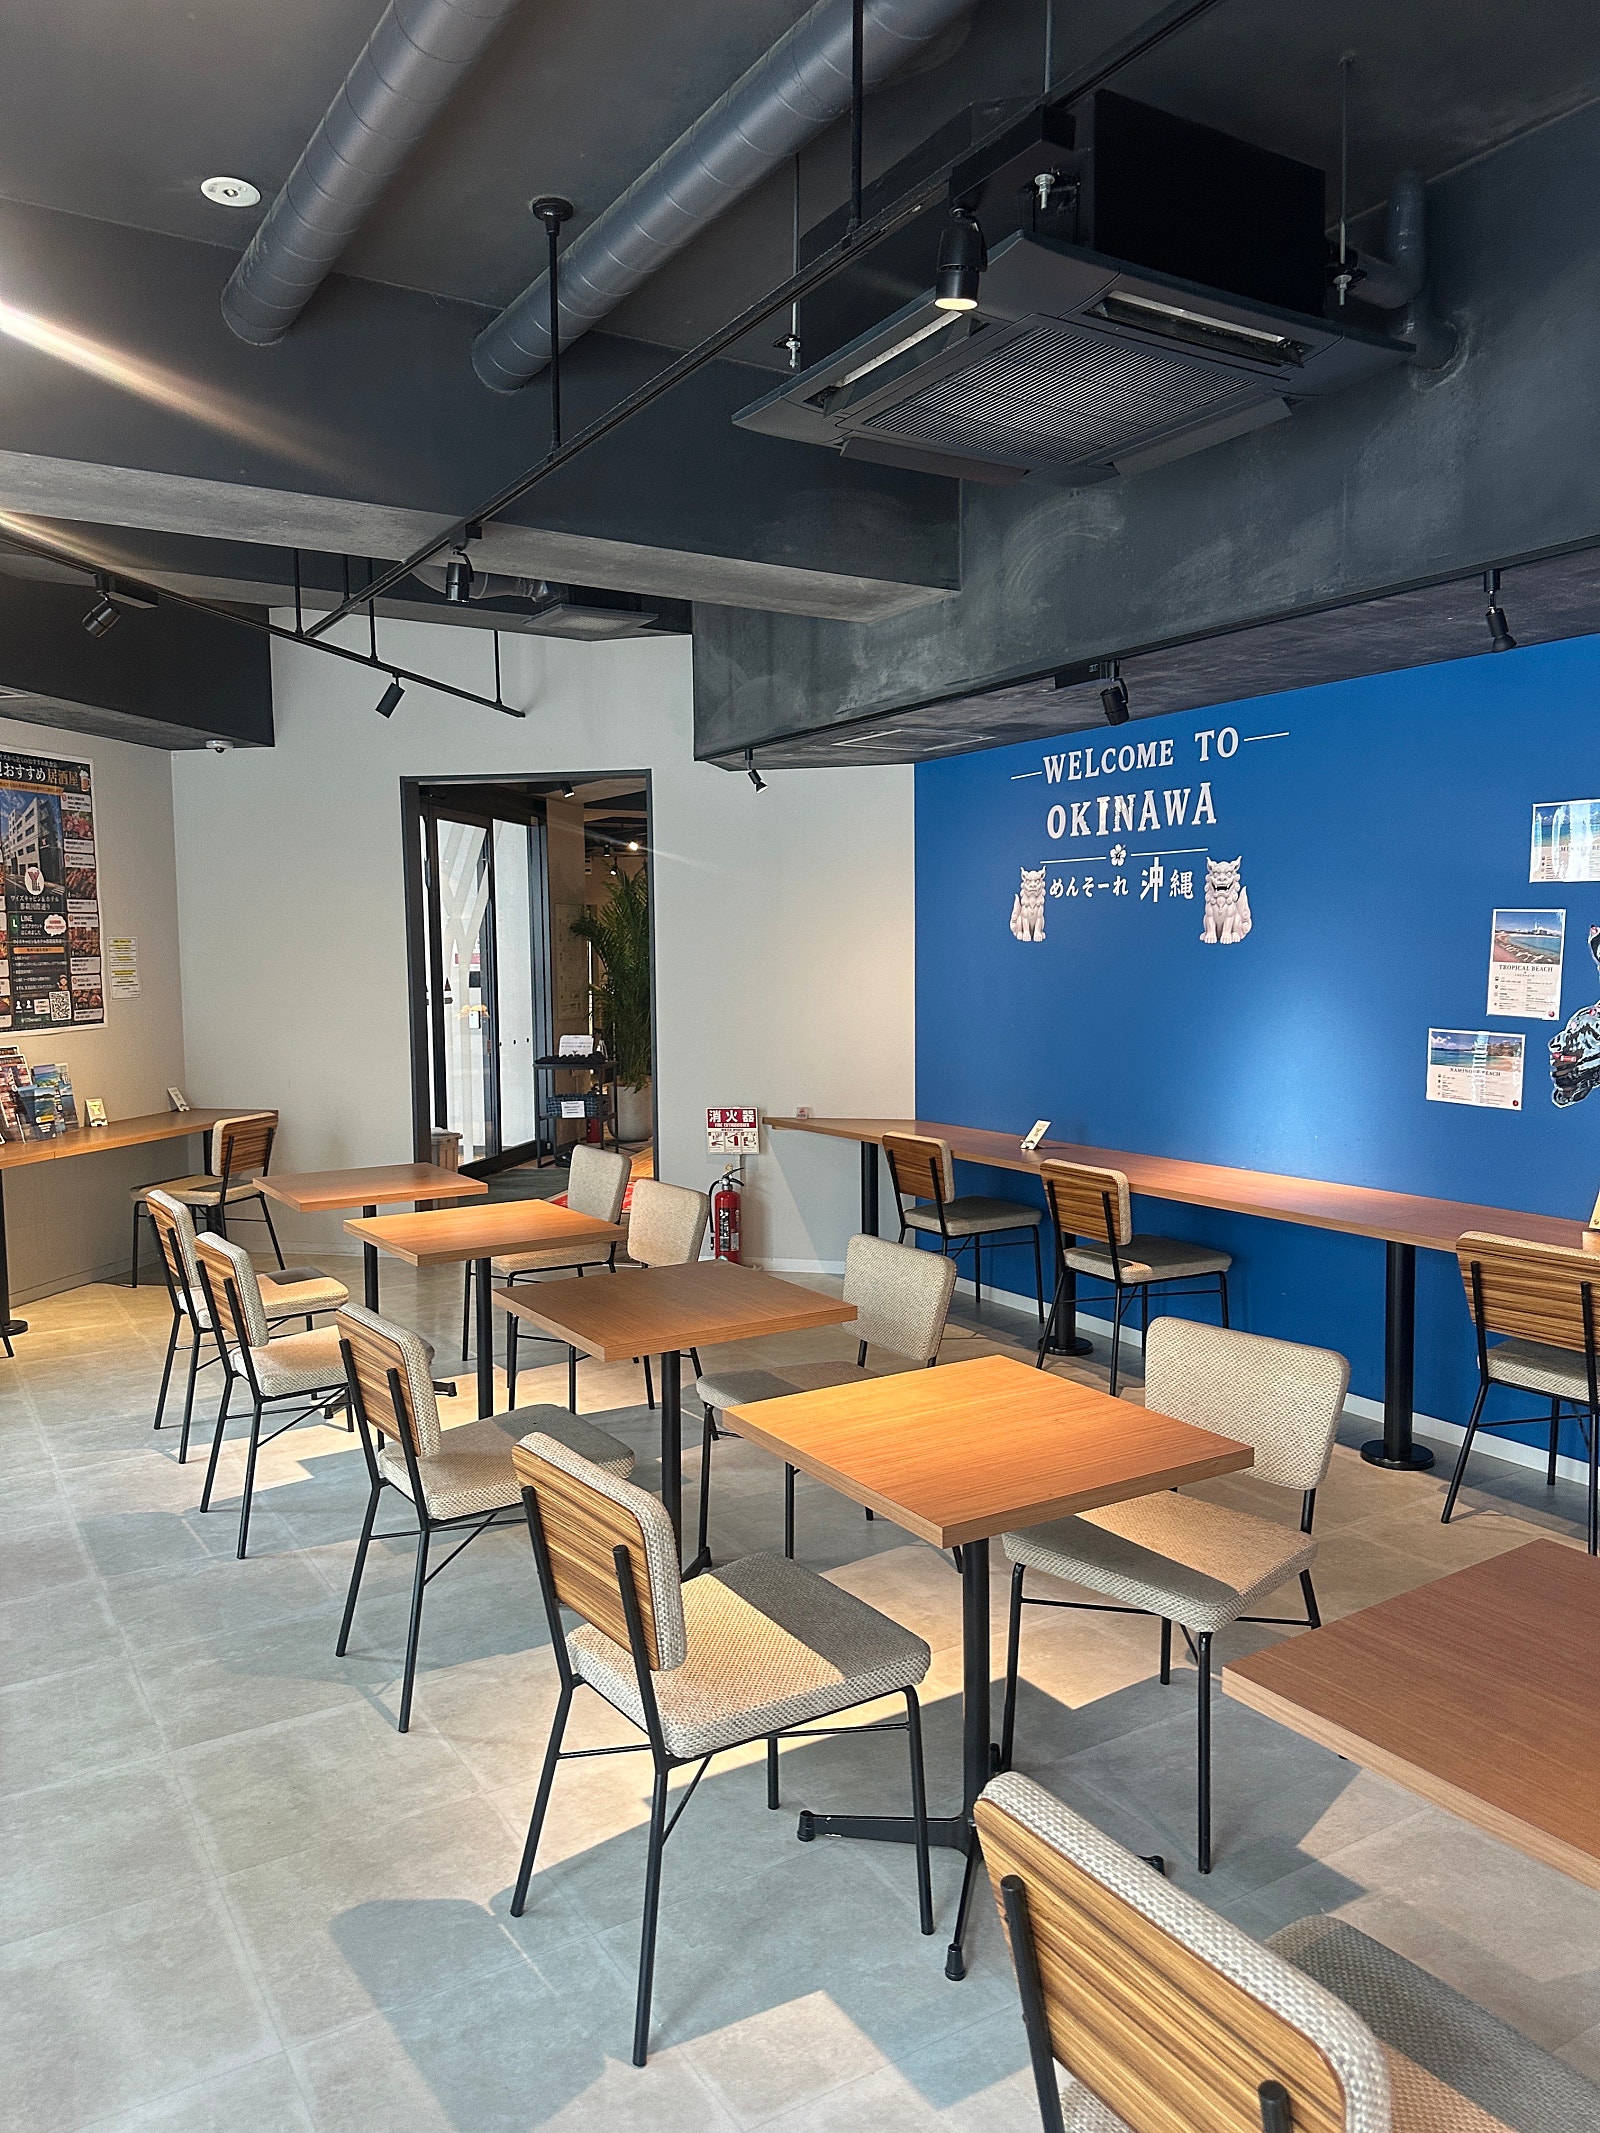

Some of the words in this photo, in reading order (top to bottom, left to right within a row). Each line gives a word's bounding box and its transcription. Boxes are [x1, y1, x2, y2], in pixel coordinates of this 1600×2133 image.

[0, 762, 79, 786] おすすめ居酒屋
[1043, 739, 1174, 784] WELCOME
[1195, 727, 1239, 762] TO
[1047, 782, 1217, 839] OKINAWA
[1049, 875, 1129, 898] めんそーれ
[1140, 856, 1194, 902] 沖縄
[709, 1110, 755, 1122] 消火器
